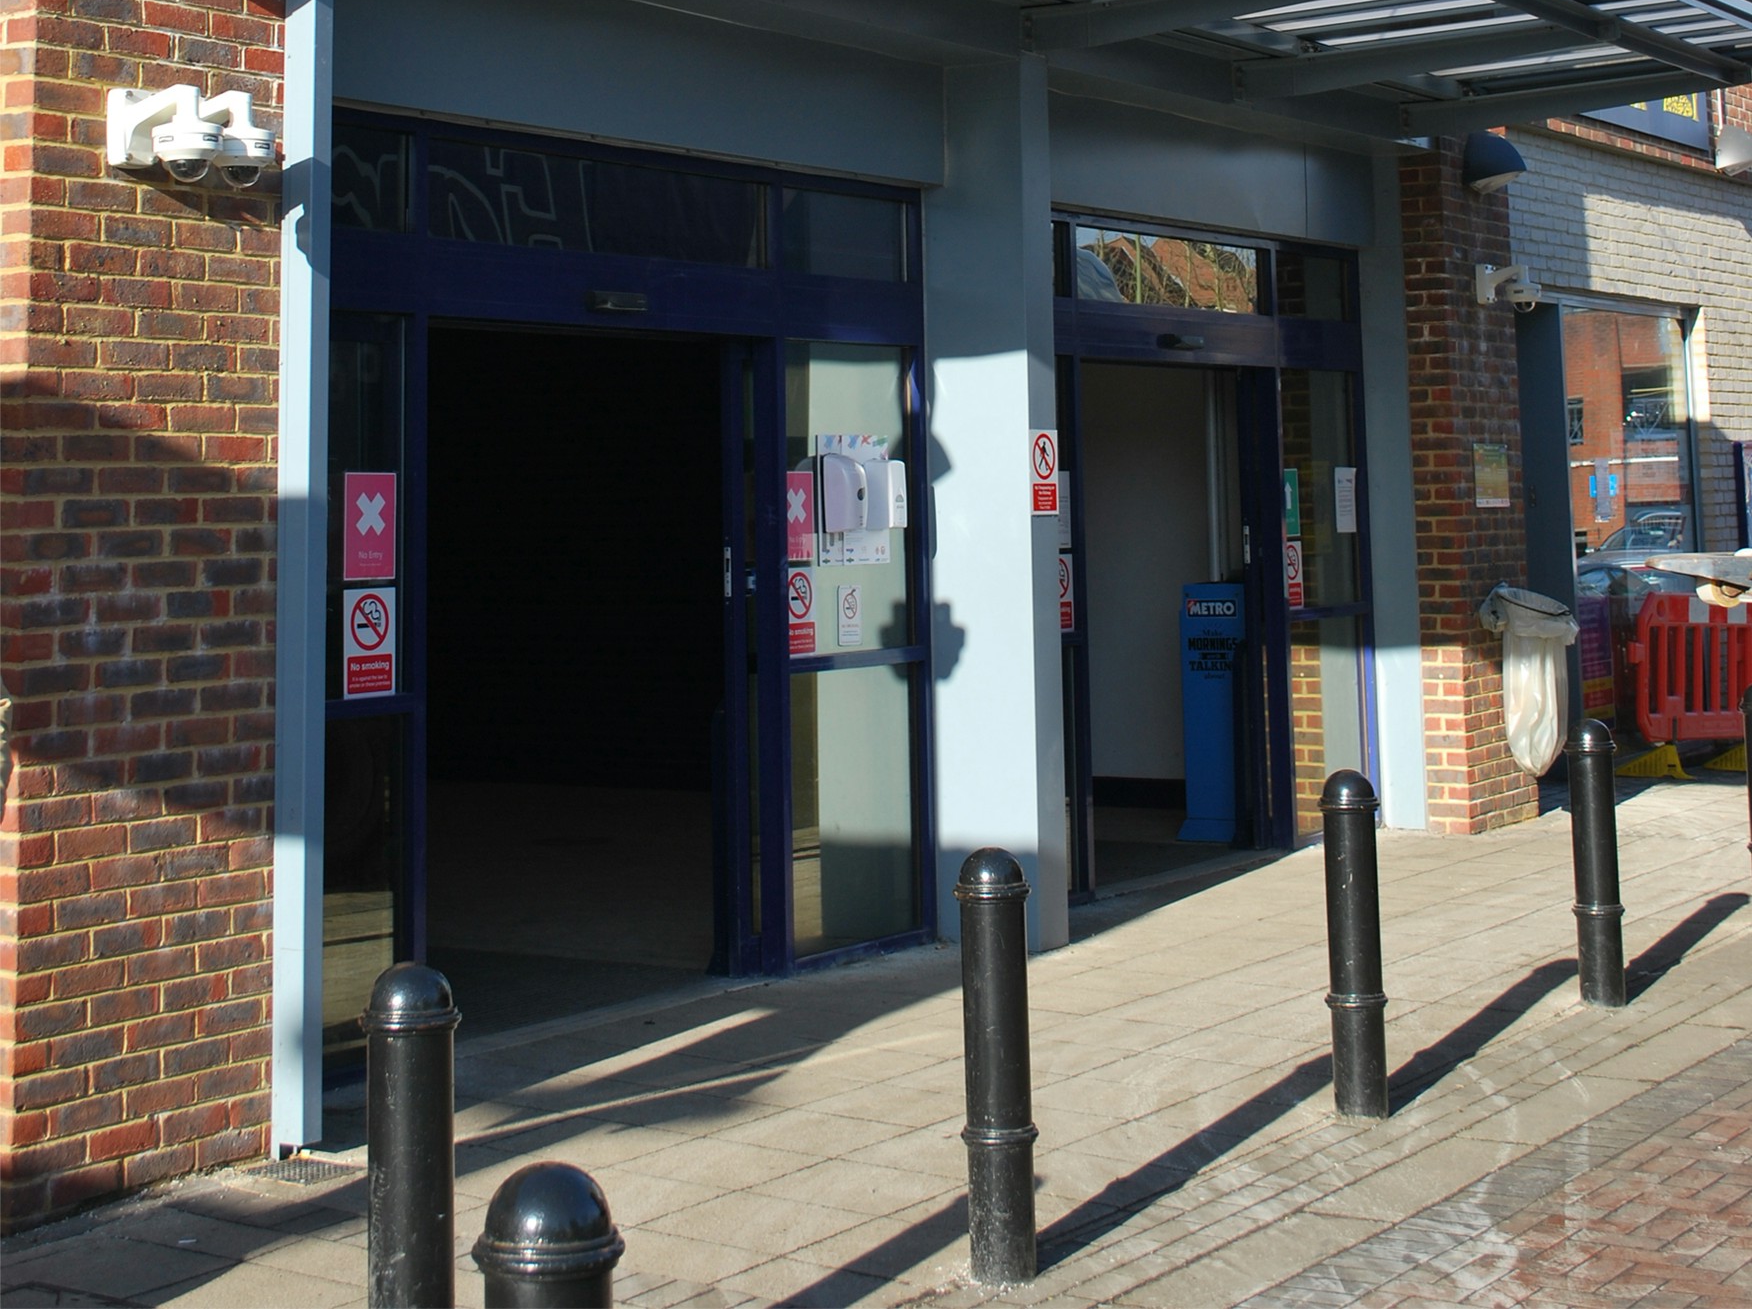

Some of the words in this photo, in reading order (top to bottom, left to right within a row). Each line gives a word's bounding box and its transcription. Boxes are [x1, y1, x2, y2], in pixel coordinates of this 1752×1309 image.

[1189, 601, 1235, 615] METRO
[1188, 637, 1238, 651] MORNINGS
[350, 662, 360, 671] No
[361, 660, 390, 671] smoking
[1189, 660, 1233, 671] TALKIN
